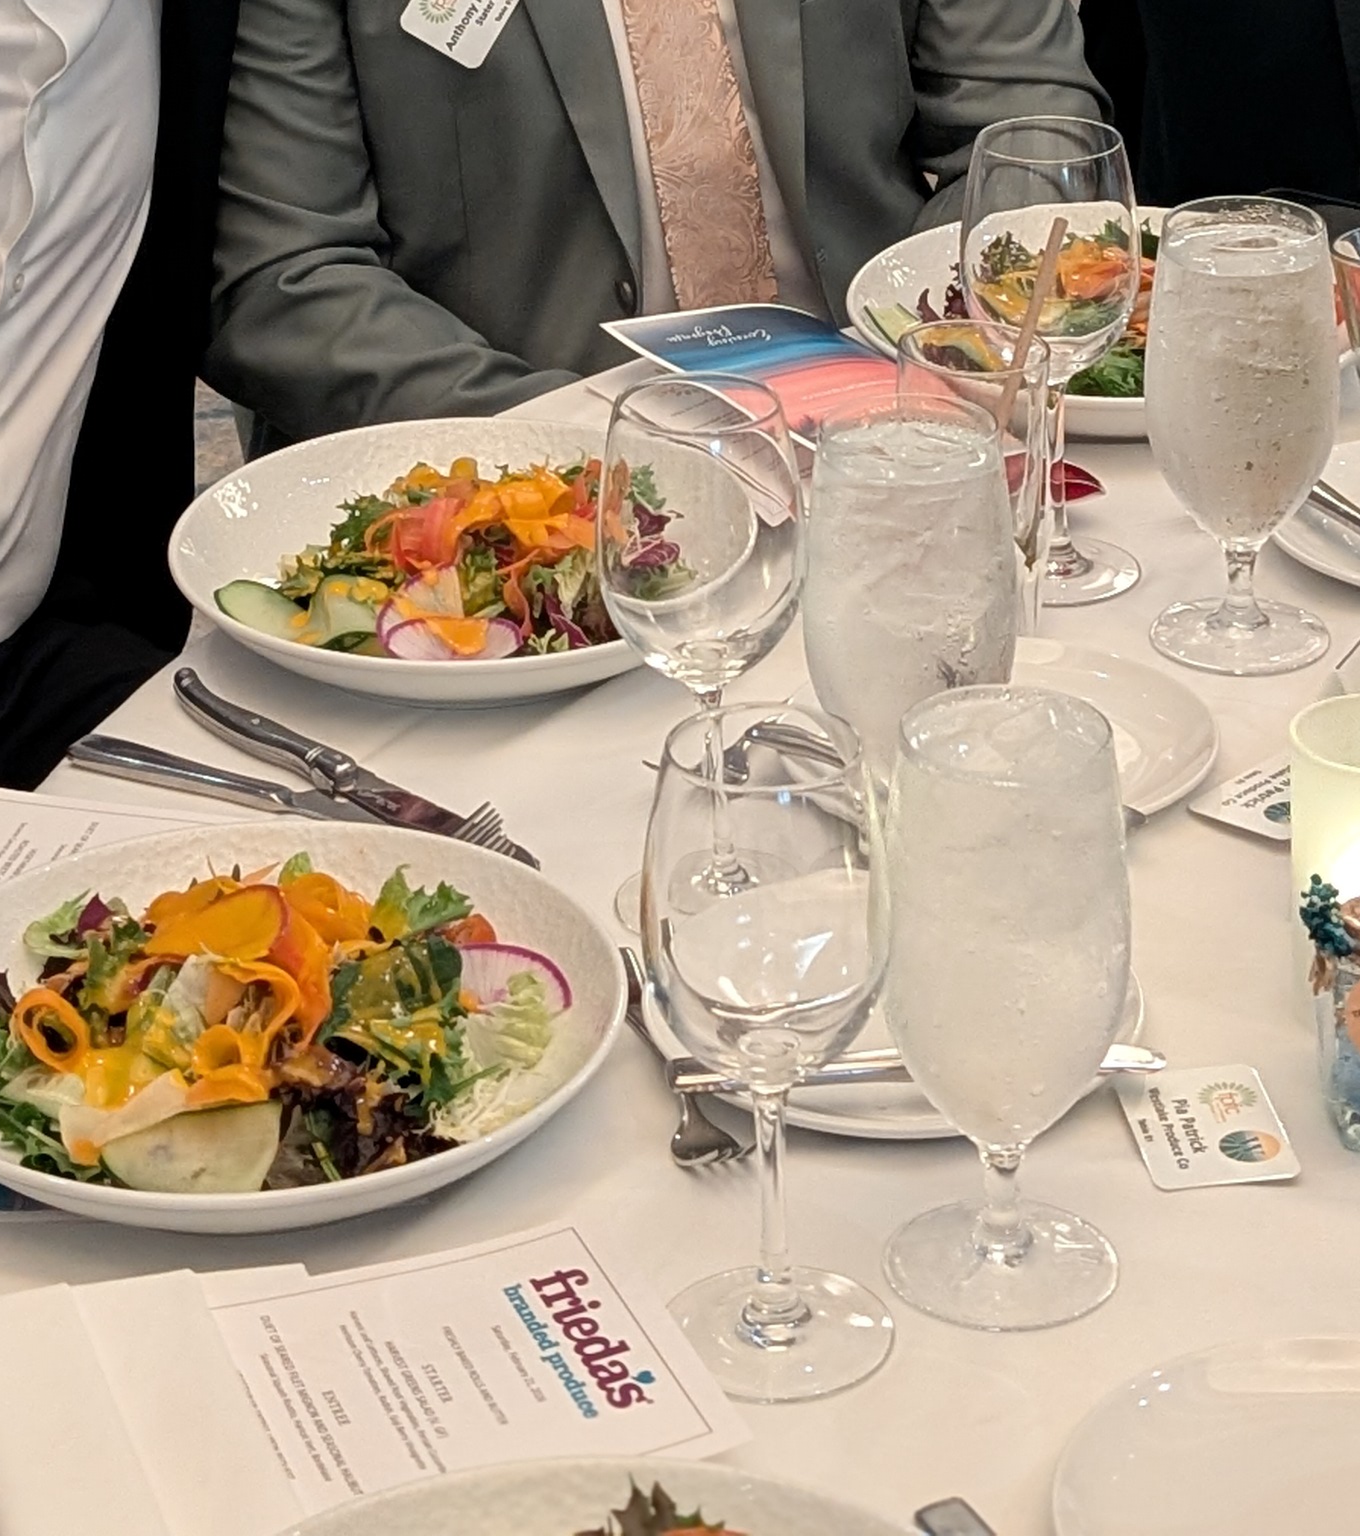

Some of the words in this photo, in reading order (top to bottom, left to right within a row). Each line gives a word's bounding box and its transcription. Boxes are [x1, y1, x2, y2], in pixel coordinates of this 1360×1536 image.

[445, 2, 478, 52] Anthony
[475, 1, 495, 26] Stater
[1171, 1098, 1190, 1115] Pia
[1161, 1123, 1184, 1157] Produce
[1176, 1157, 1190, 1170] Co
[1179, 1117, 1208, 1154] Patrick
[260, 1315, 277, 1333] DUET
[269, 1334, 282, 1343] OF
[529, 1269, 655, 1408] frieda's
[274, 1345, 295, 1370] SEARED
[443, 1326, 461, 1349] FRESHLY
[455, 1350, 473, 1369] BAKED
[469, 1370, 485, 1388] ROLLS
[480, 1389, 493, 1401] AND
[503, 1283, 560, 1351] branded
[540, 1352, 598, 1418] produce
[289, 1371, 305, 1387] FILET
[385, 1341, 408, 1368] HARVEST
[401, 1370, 423, 1395] GREENS
[415, 1395, 435, 1416] SALAD
[421, 1364, 453, 1403] STARTER
[297, 1389, 319, 1418] MIGNON
[314, 1419, 328, 1433] AND
[320, 1434, 346, 1467] SEASONAL
[341, 1468, 364, 1495] HALIBUT
